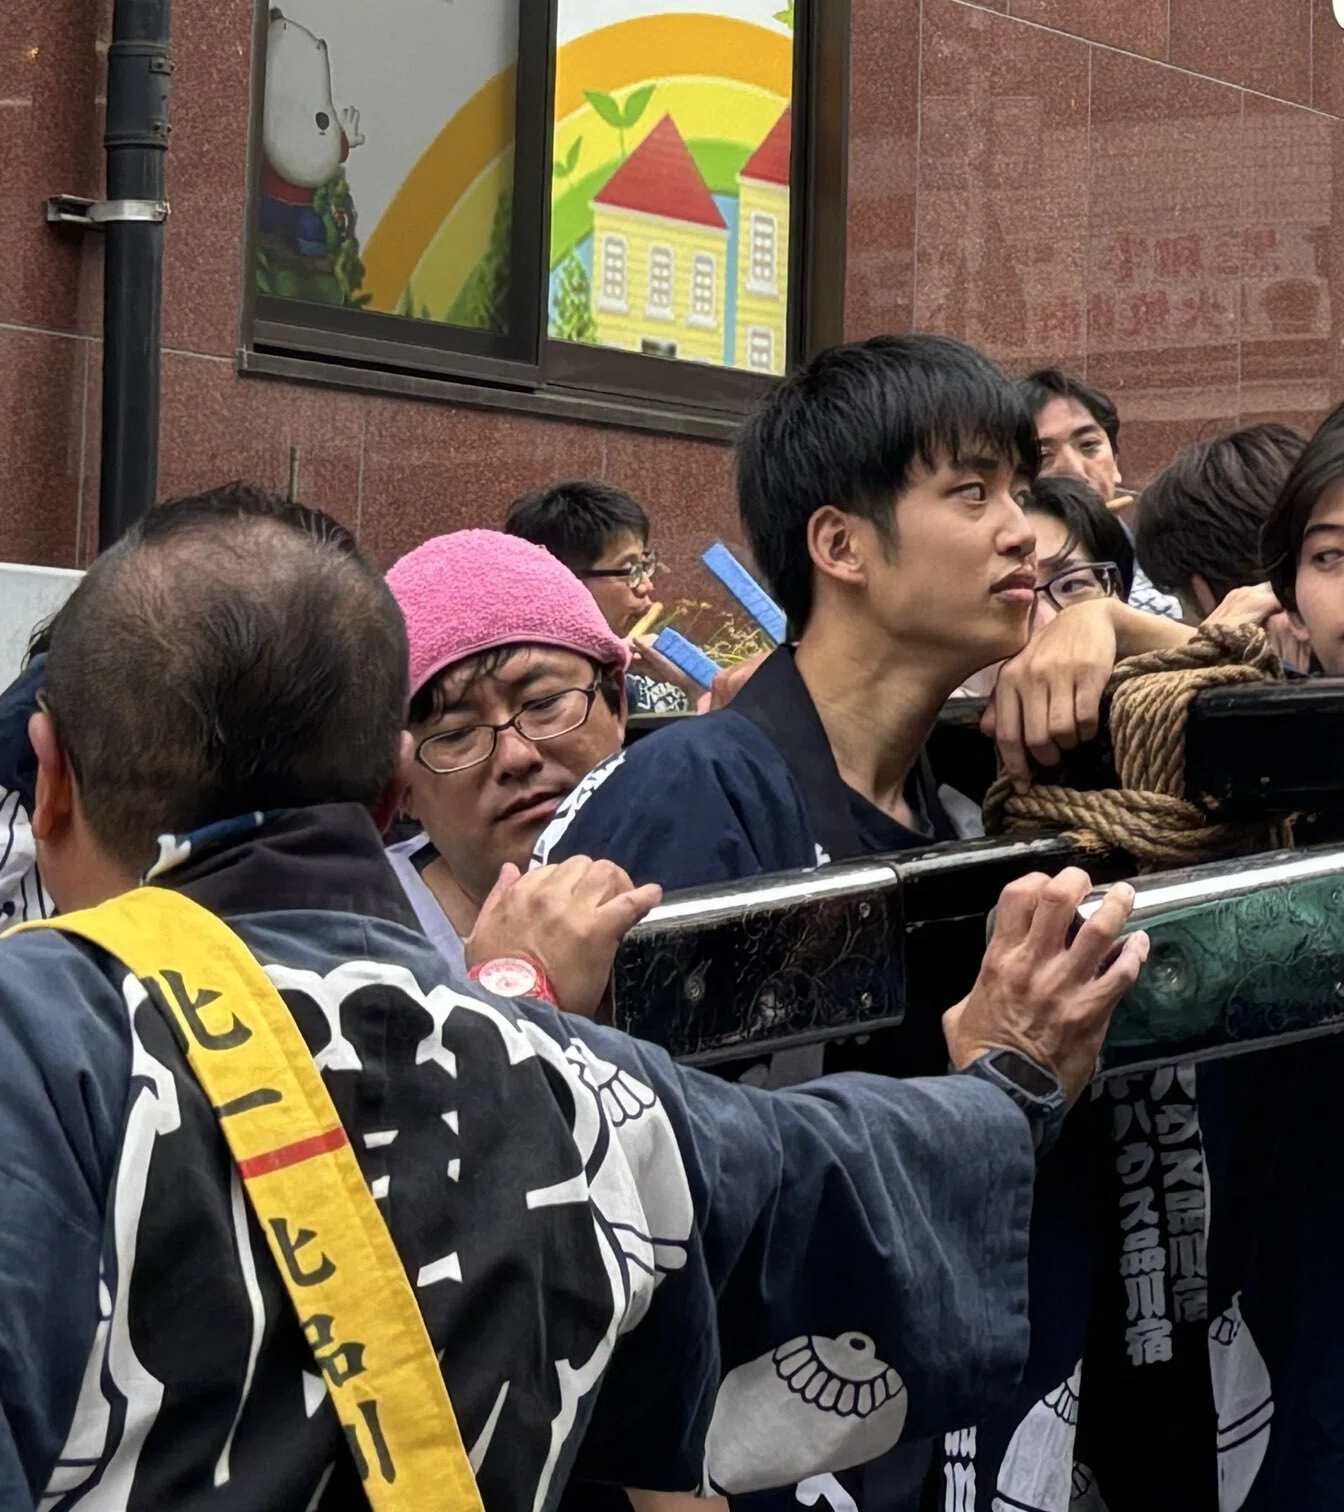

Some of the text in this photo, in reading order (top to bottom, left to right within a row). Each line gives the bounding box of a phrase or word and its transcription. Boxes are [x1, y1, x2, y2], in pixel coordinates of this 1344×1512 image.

[1092, 1072, 1173, 1367] ハウス品川宿
